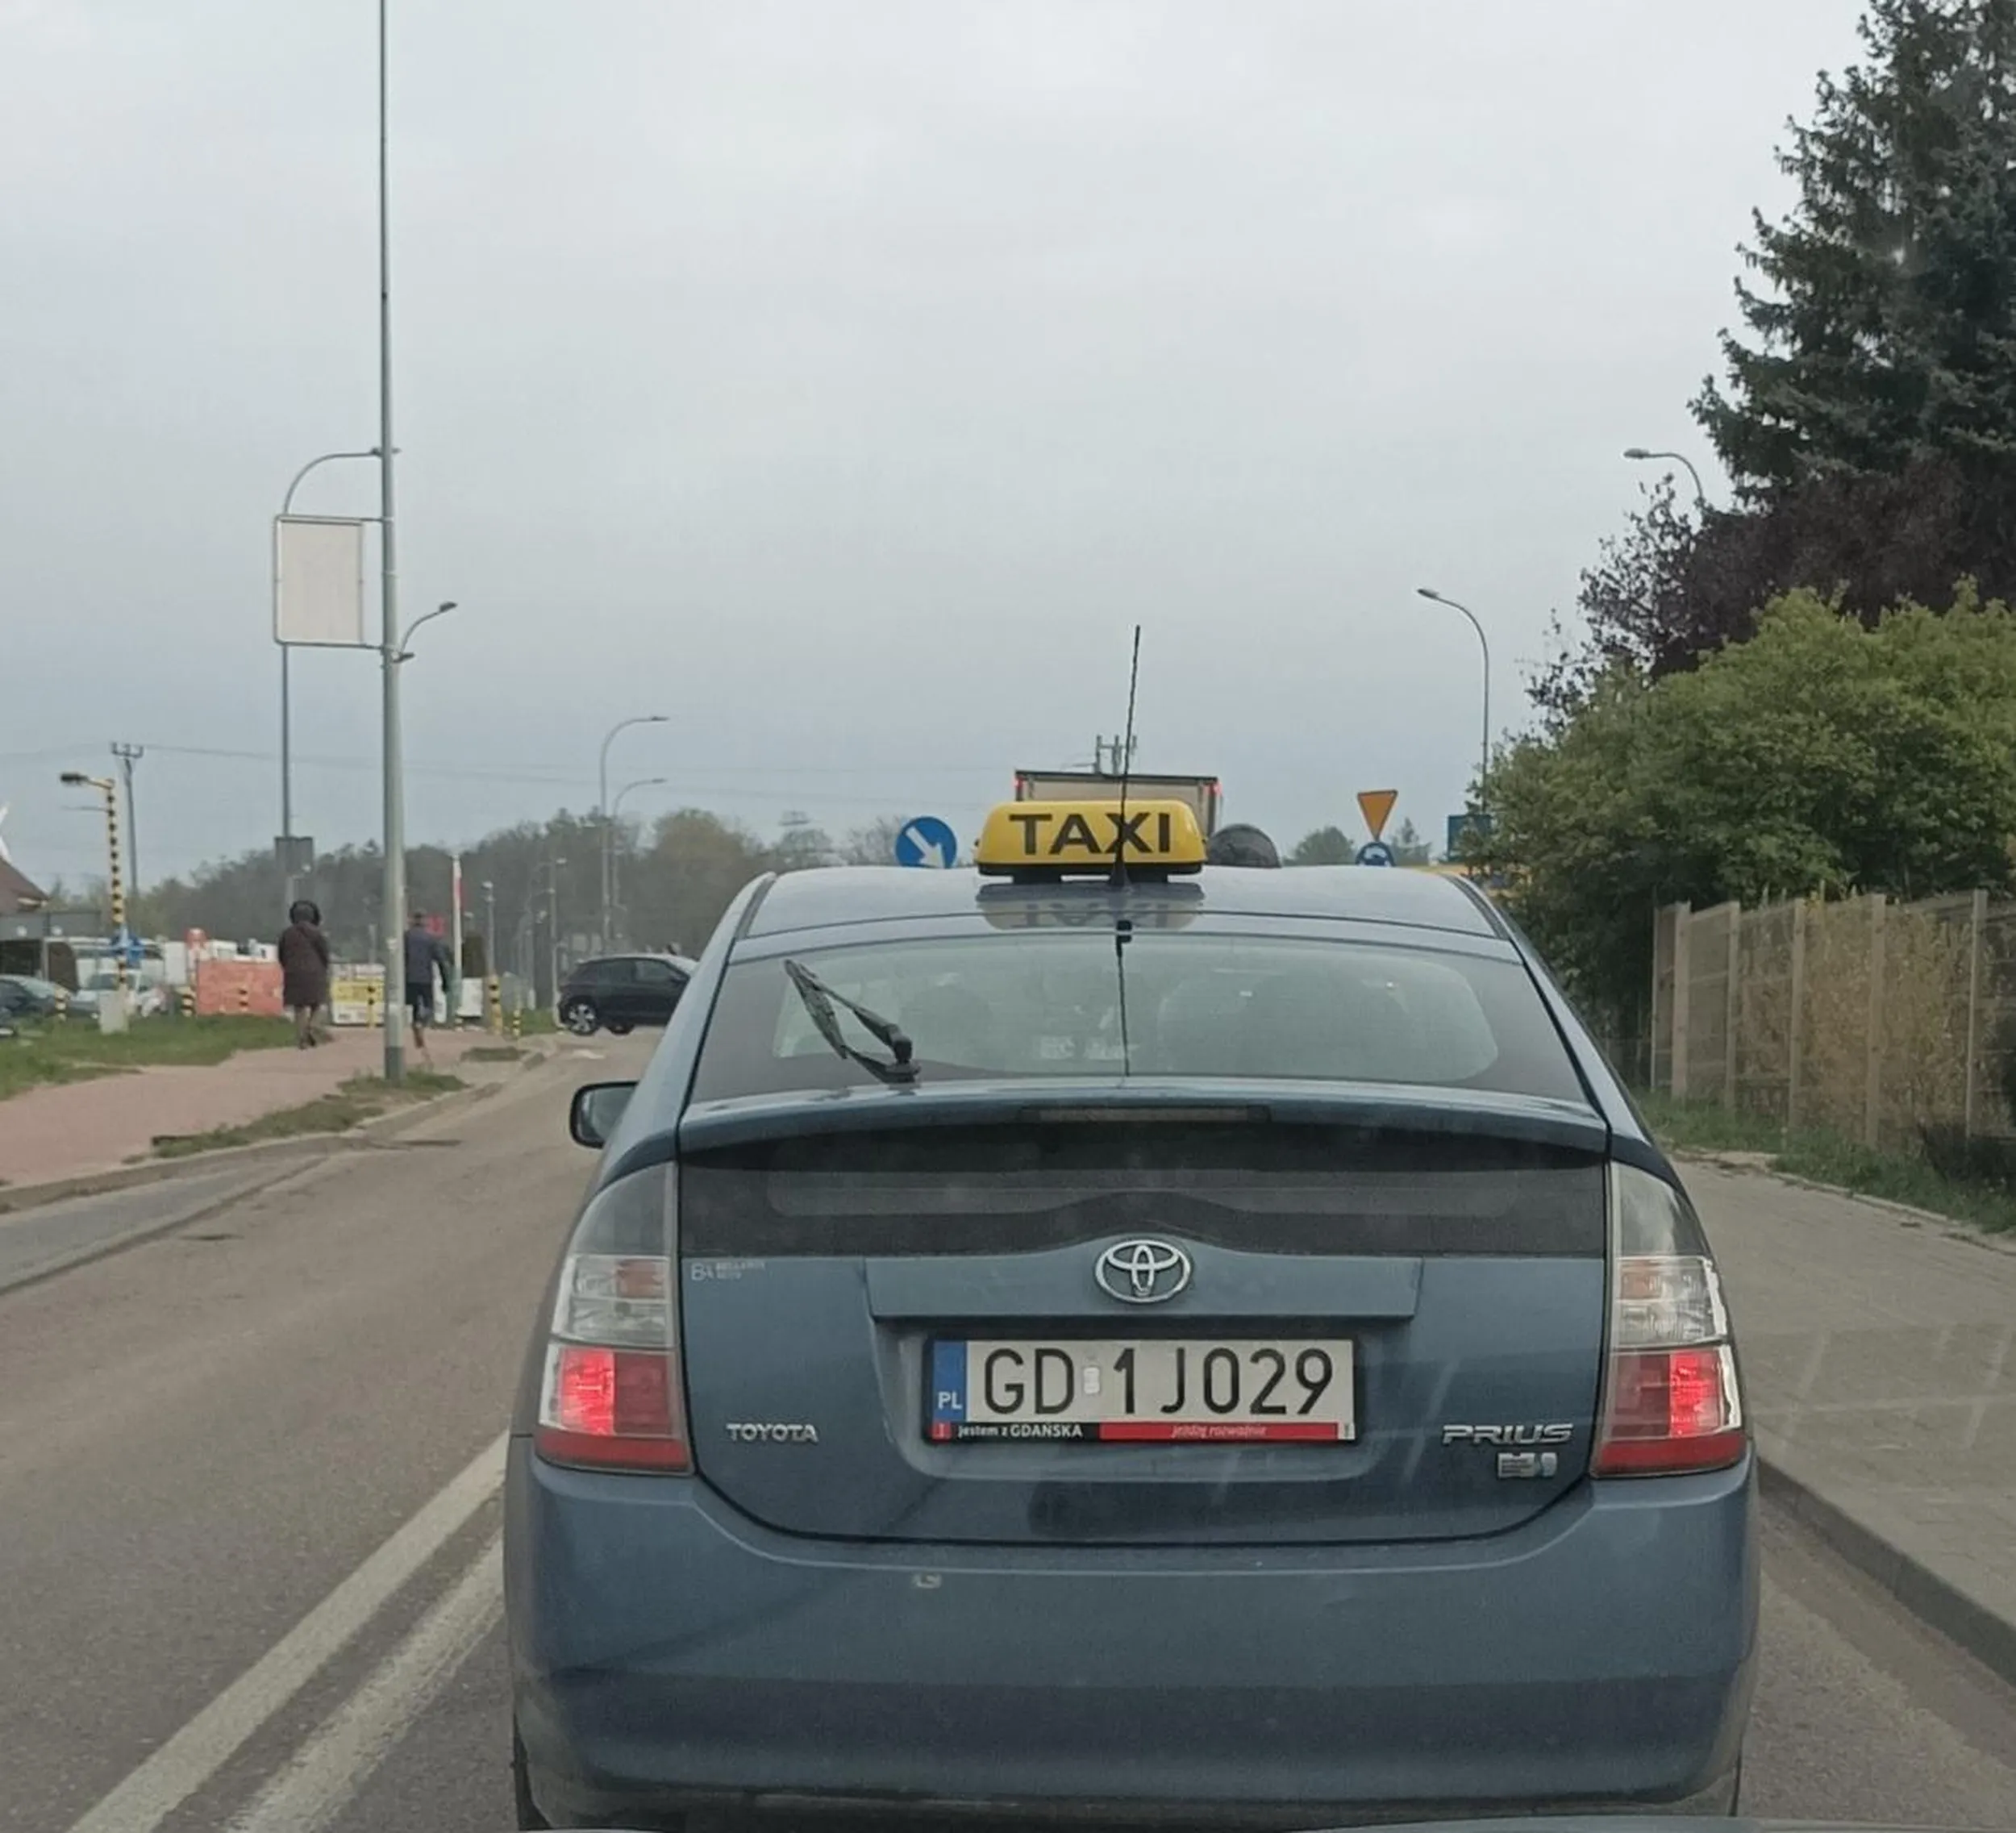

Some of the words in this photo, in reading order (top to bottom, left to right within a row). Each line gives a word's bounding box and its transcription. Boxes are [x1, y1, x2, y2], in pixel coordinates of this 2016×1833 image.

[1009, 812, 1171, 856] TAXI
[984, 1348, 1075, 1414] GD
[1113, 1348, 1333, 1414] 1J029
[938, 1391, 963, 1409] PL
[726, 1423, 818, 1443] TOYOTA
[958, 1425, 998, 1439] jestem
[1001, 1427, 1008, 1436] z
[1010, 1423, 1084, 1437] GDAŃSKA
[1442, 1423, 1574, 1445] PRIUS
